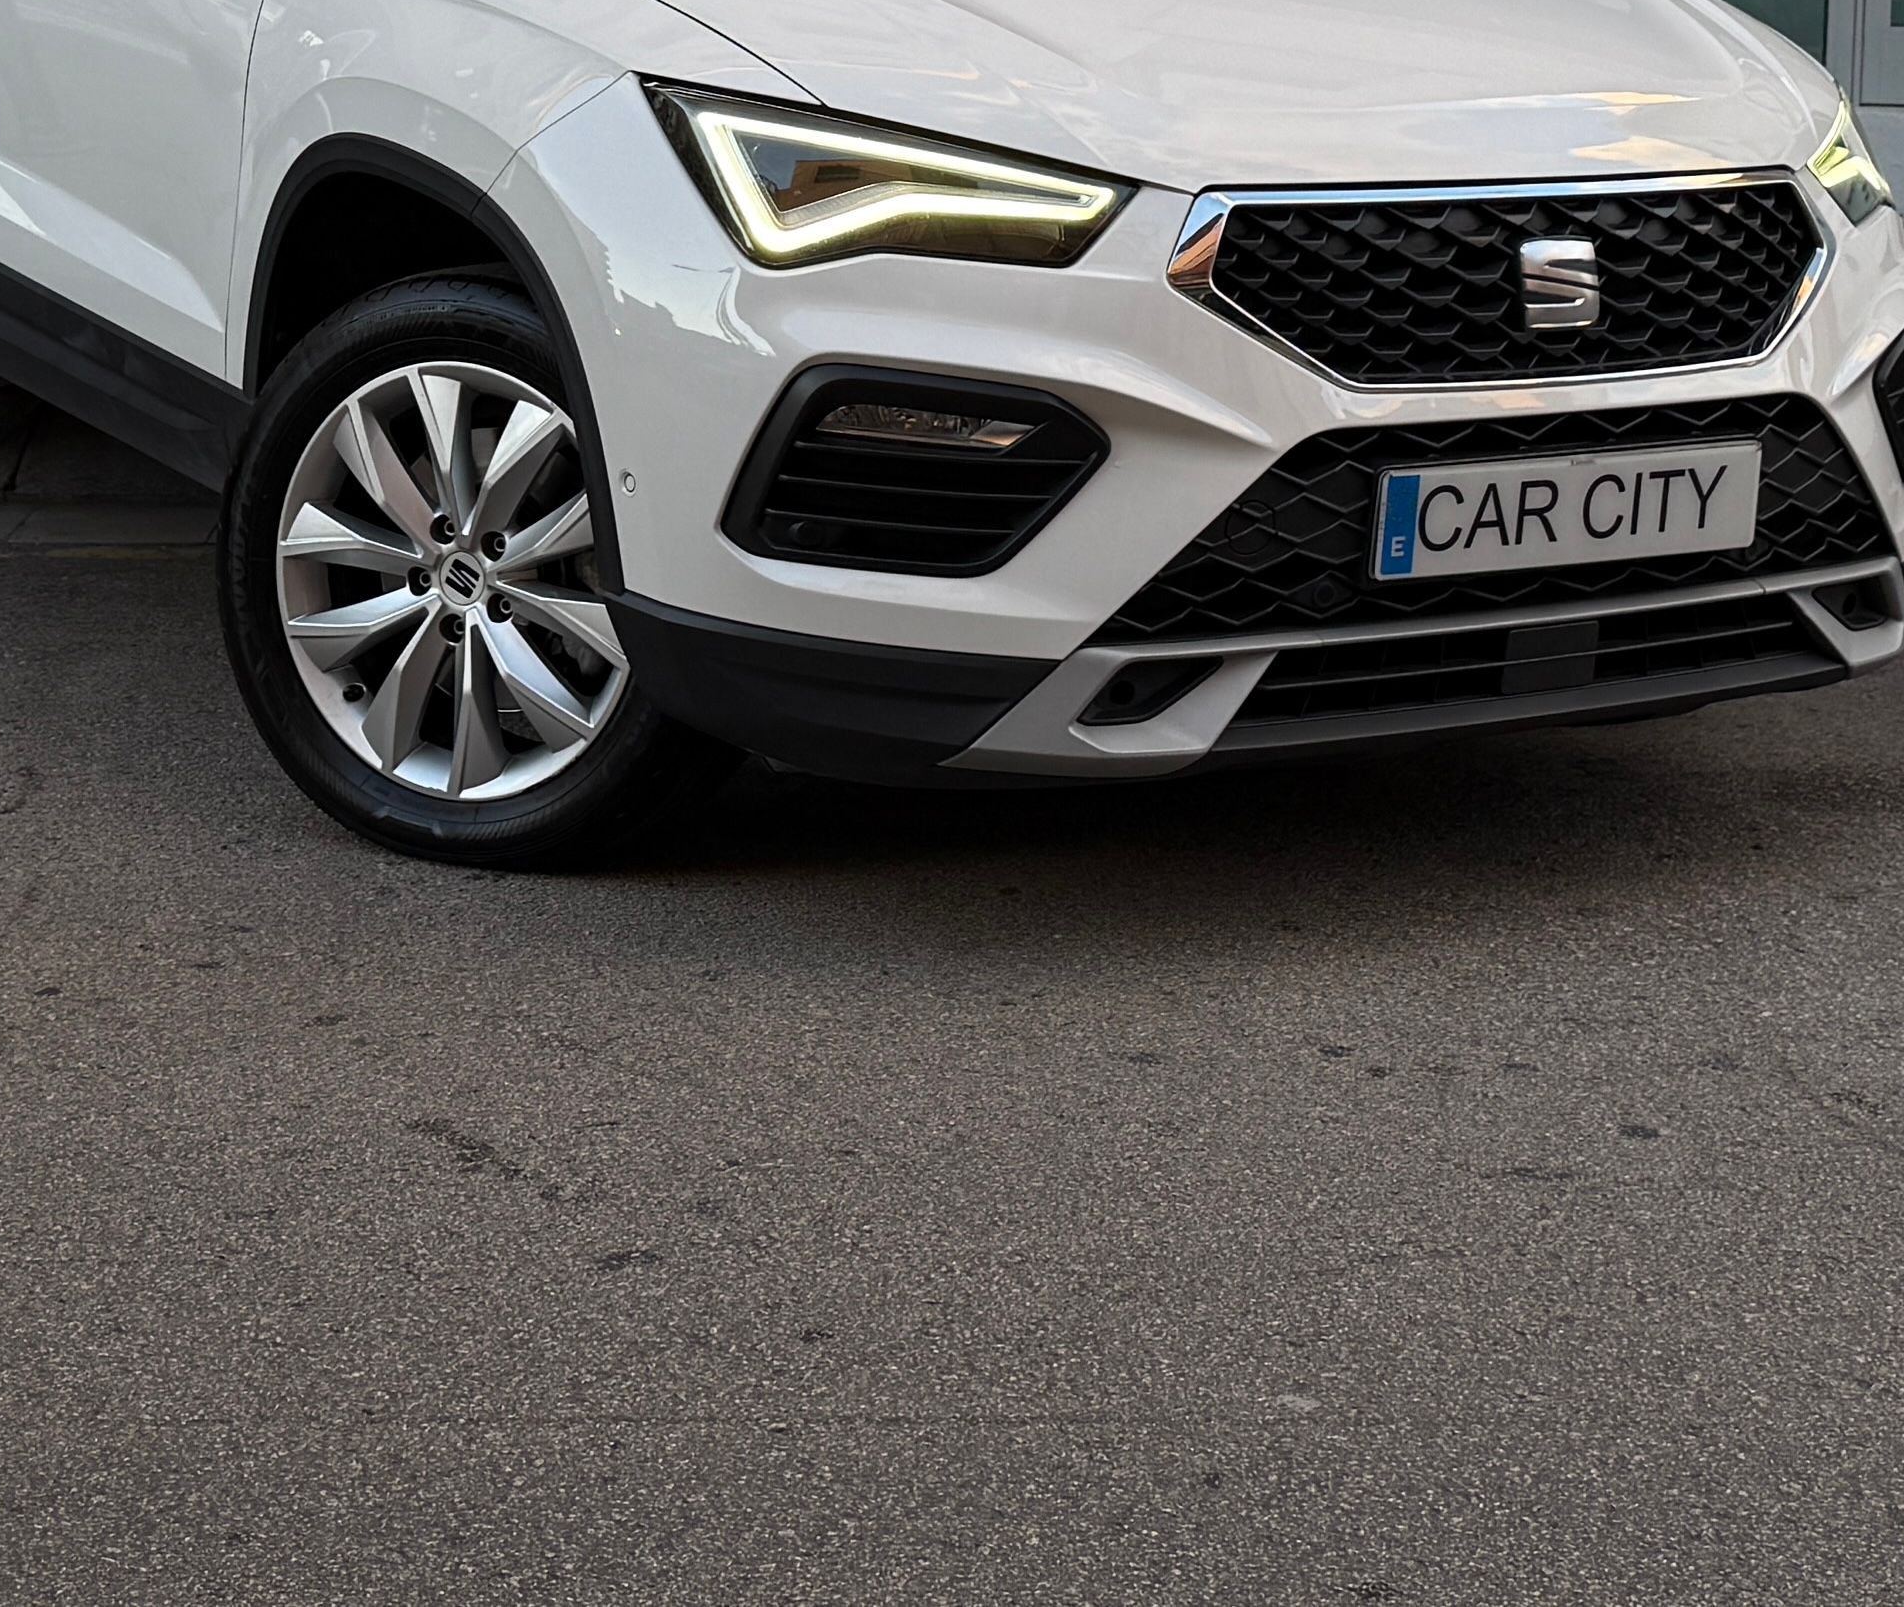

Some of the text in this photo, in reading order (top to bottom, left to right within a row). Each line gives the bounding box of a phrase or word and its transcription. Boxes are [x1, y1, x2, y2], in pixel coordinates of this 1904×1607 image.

[1418, 465, 1728, 552] CAR CITY
[1391, 535, 1407, 558] E
